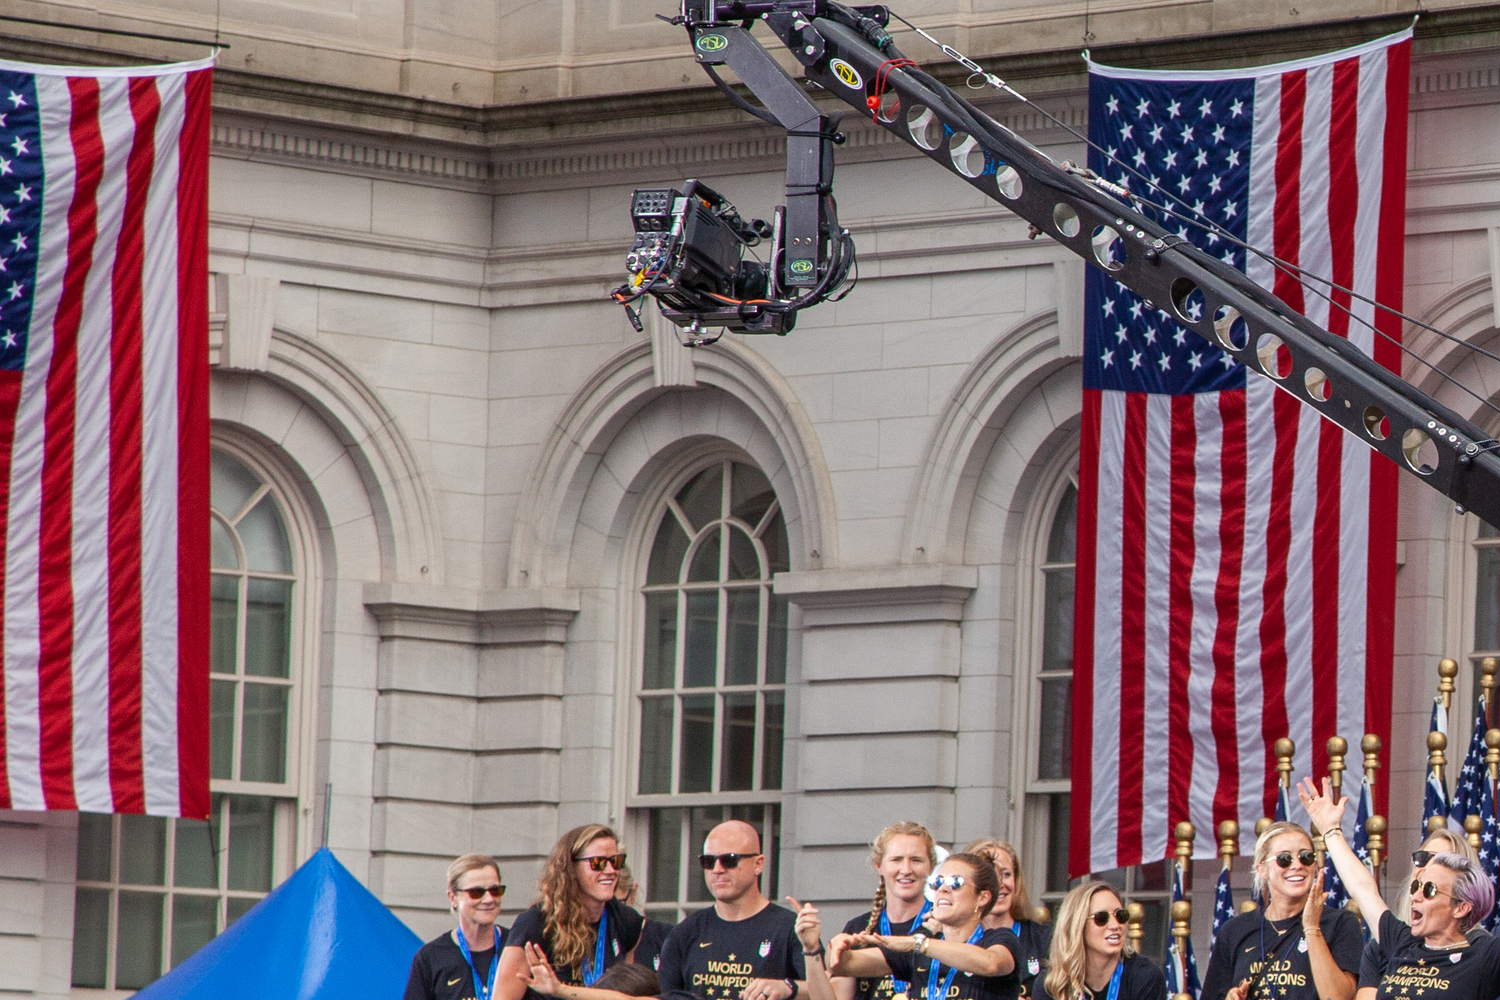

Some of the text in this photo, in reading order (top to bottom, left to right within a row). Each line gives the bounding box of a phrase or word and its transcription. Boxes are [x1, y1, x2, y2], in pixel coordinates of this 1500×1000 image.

[708, 961, 753, 975] WORLD
[1396, 965, 1440, 977] WORLD
[692, 973, 758, 988] CHAMPIO
